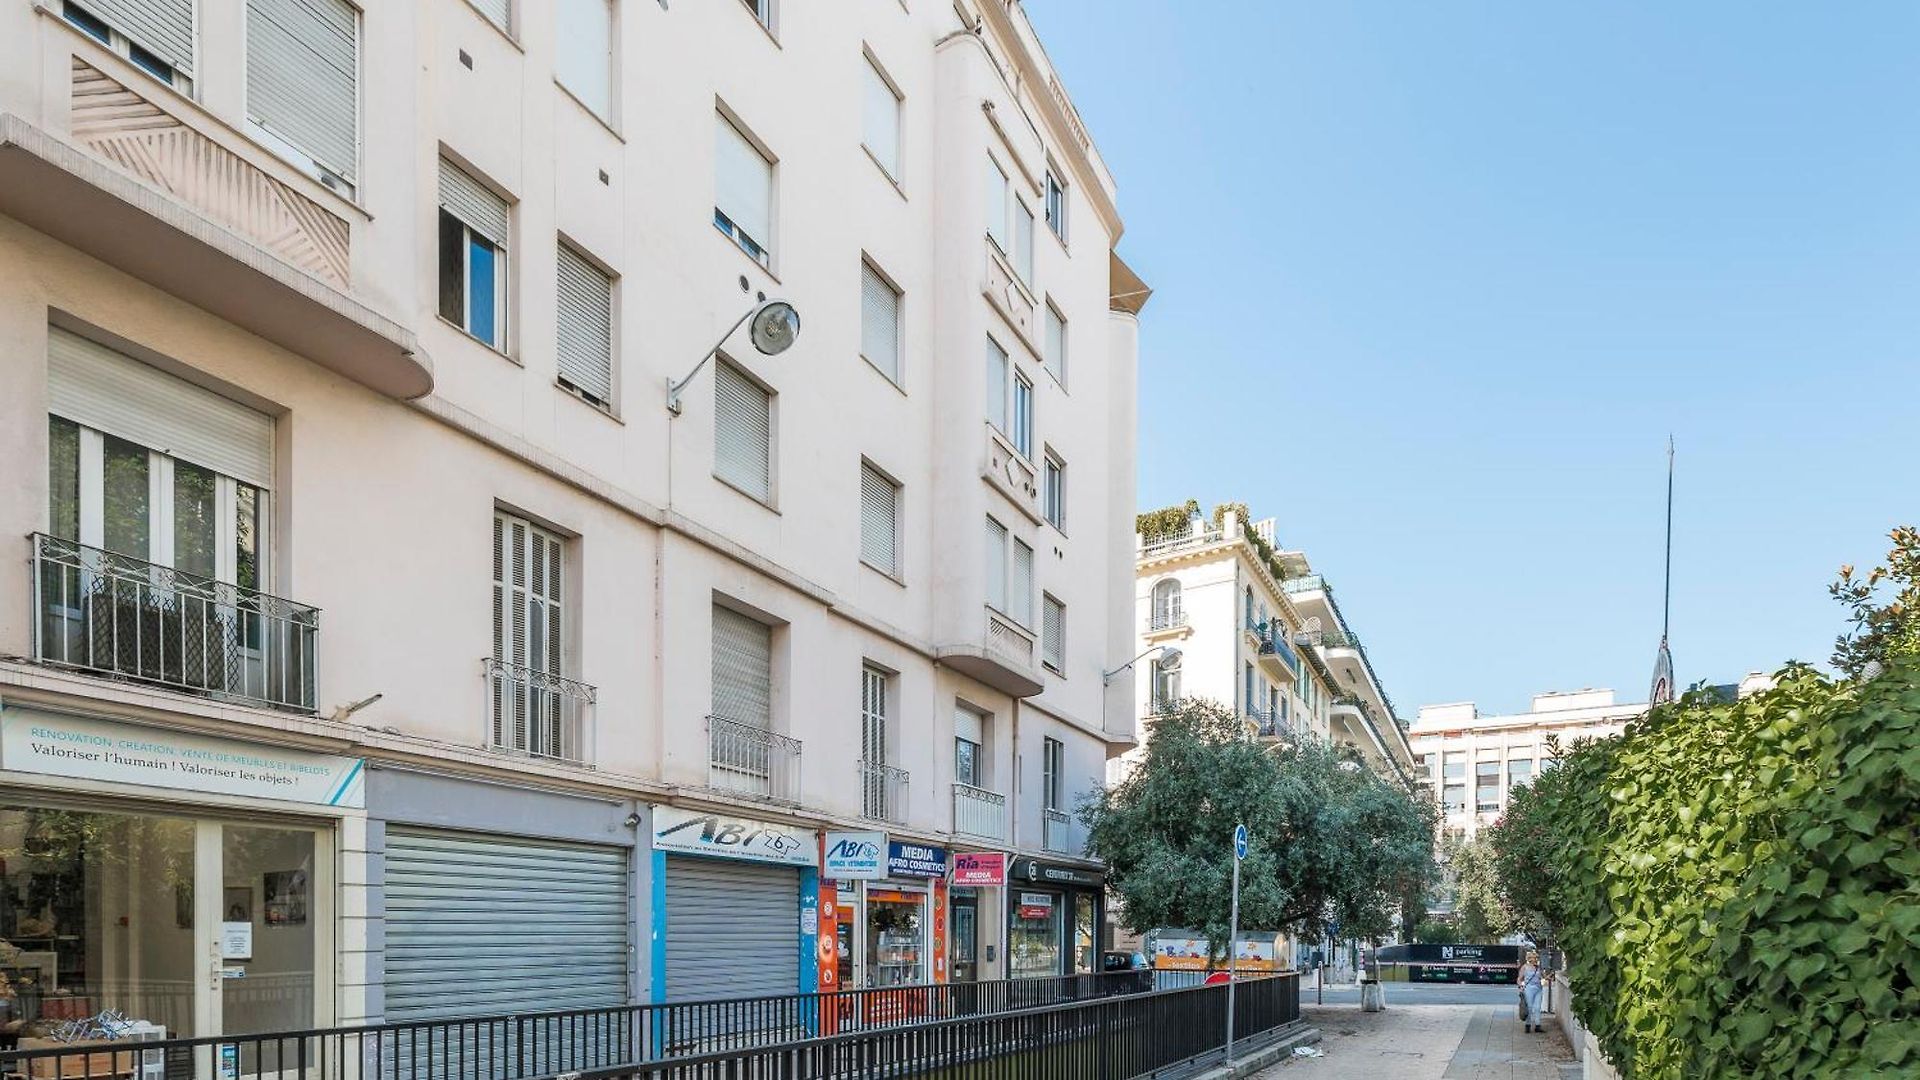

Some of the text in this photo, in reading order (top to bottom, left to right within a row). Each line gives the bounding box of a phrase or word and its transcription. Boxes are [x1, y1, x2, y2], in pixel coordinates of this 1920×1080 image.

[32, 743, 100, 761] Valoriser
[180, 762, 236, 778] Valoriser
[240, 769, 256, 781] les
[259, 772, 293, 786] objets
[901, 845, 933, 861] MEDIA
[889, 857, 946, 872] AFRO COSMETICS
[956, 855, 979, 869] Ria
[965, 871, 992, 879] MEDIA
